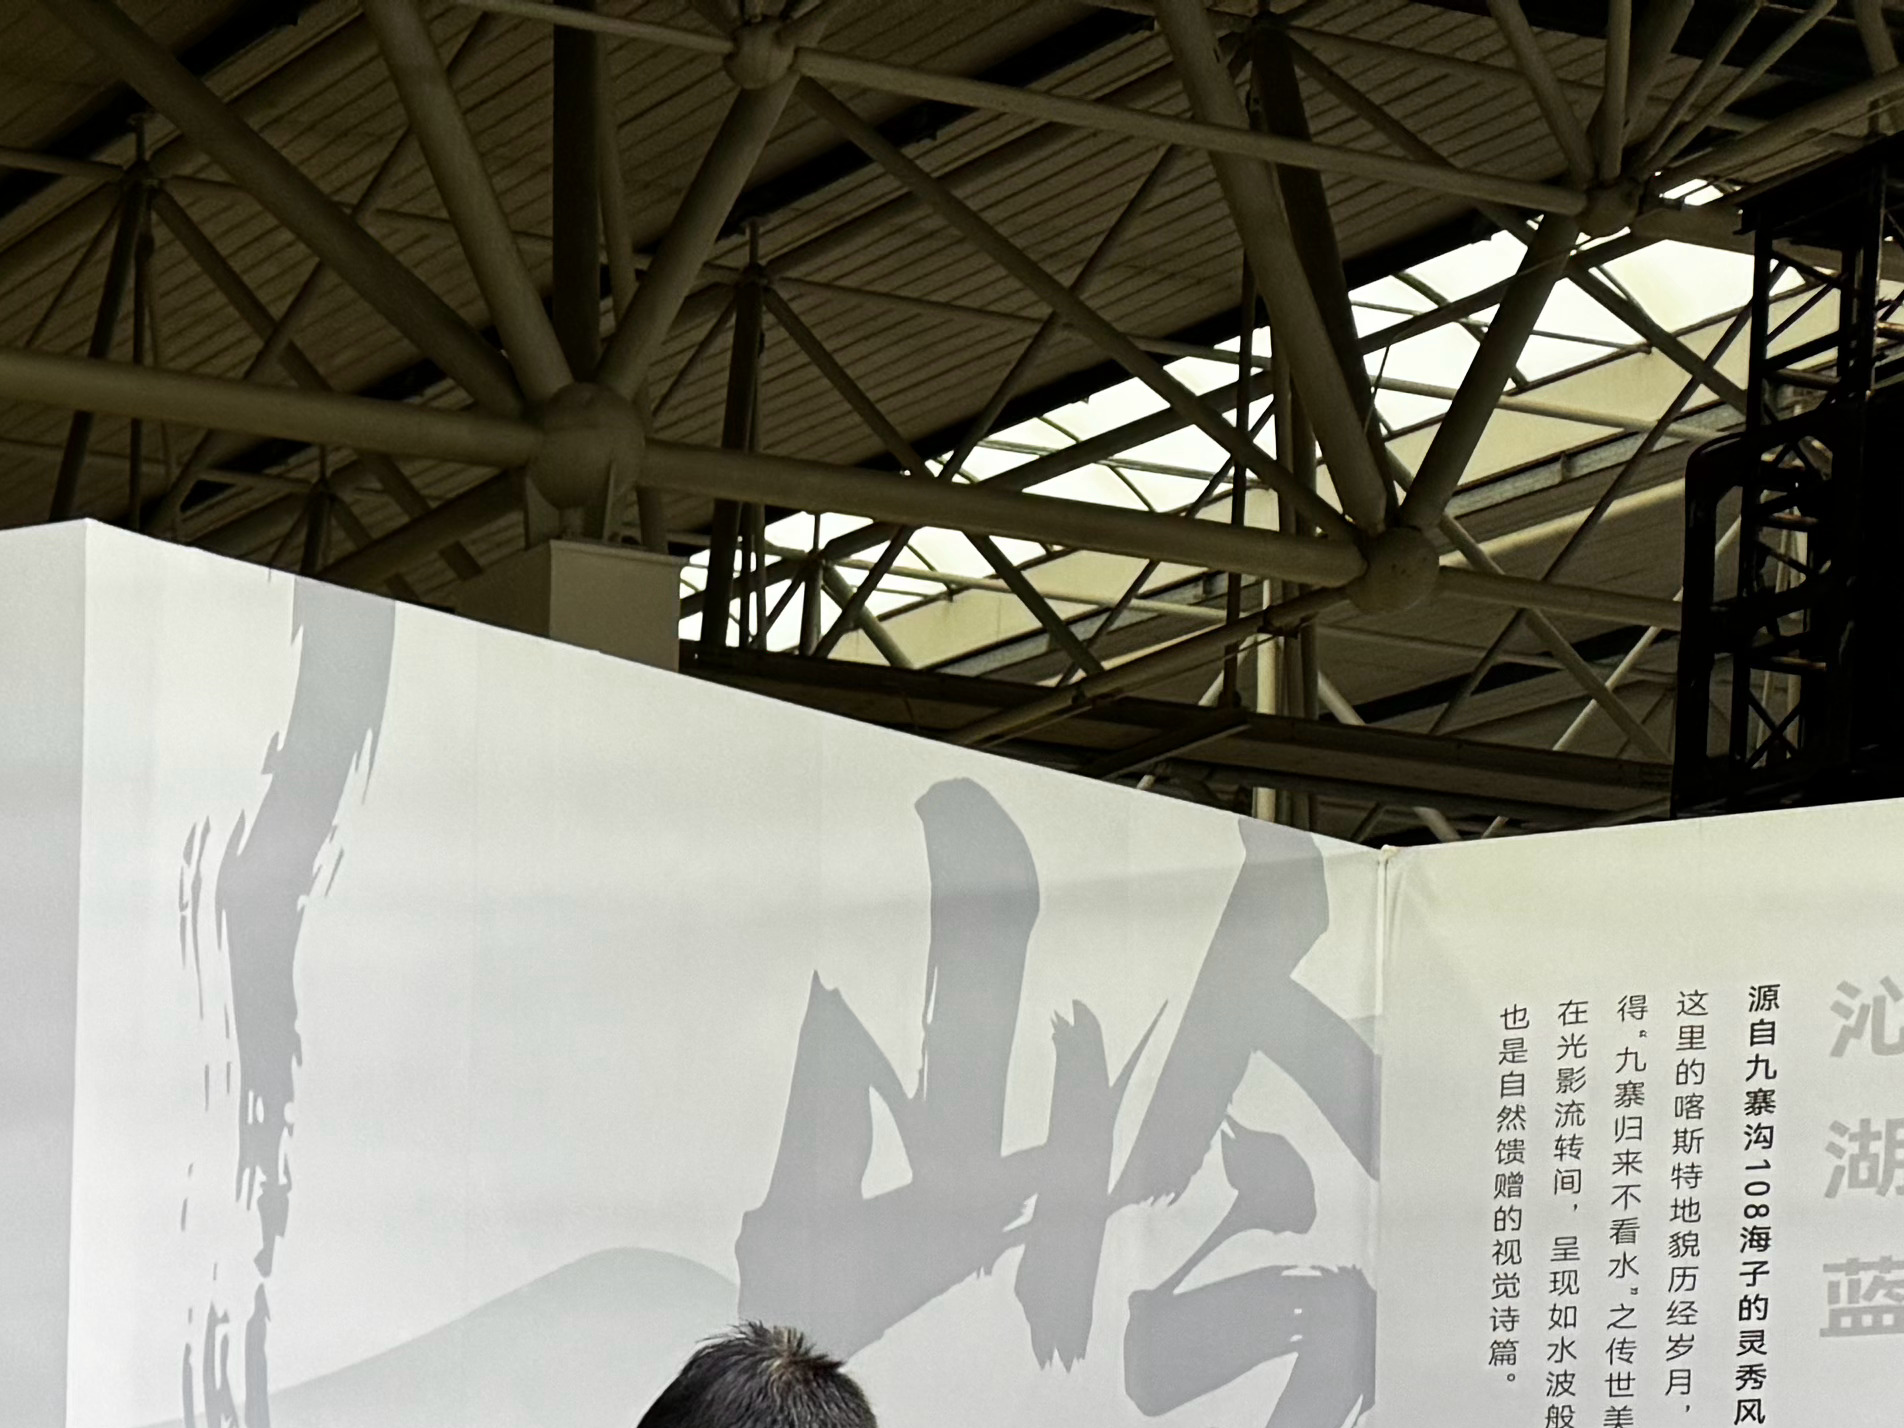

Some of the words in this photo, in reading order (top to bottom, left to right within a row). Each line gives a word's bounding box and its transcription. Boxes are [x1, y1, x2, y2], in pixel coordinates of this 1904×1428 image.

[1488, 1003, 1530, 1384] 也是自然馈赠的视觉诗篇。
